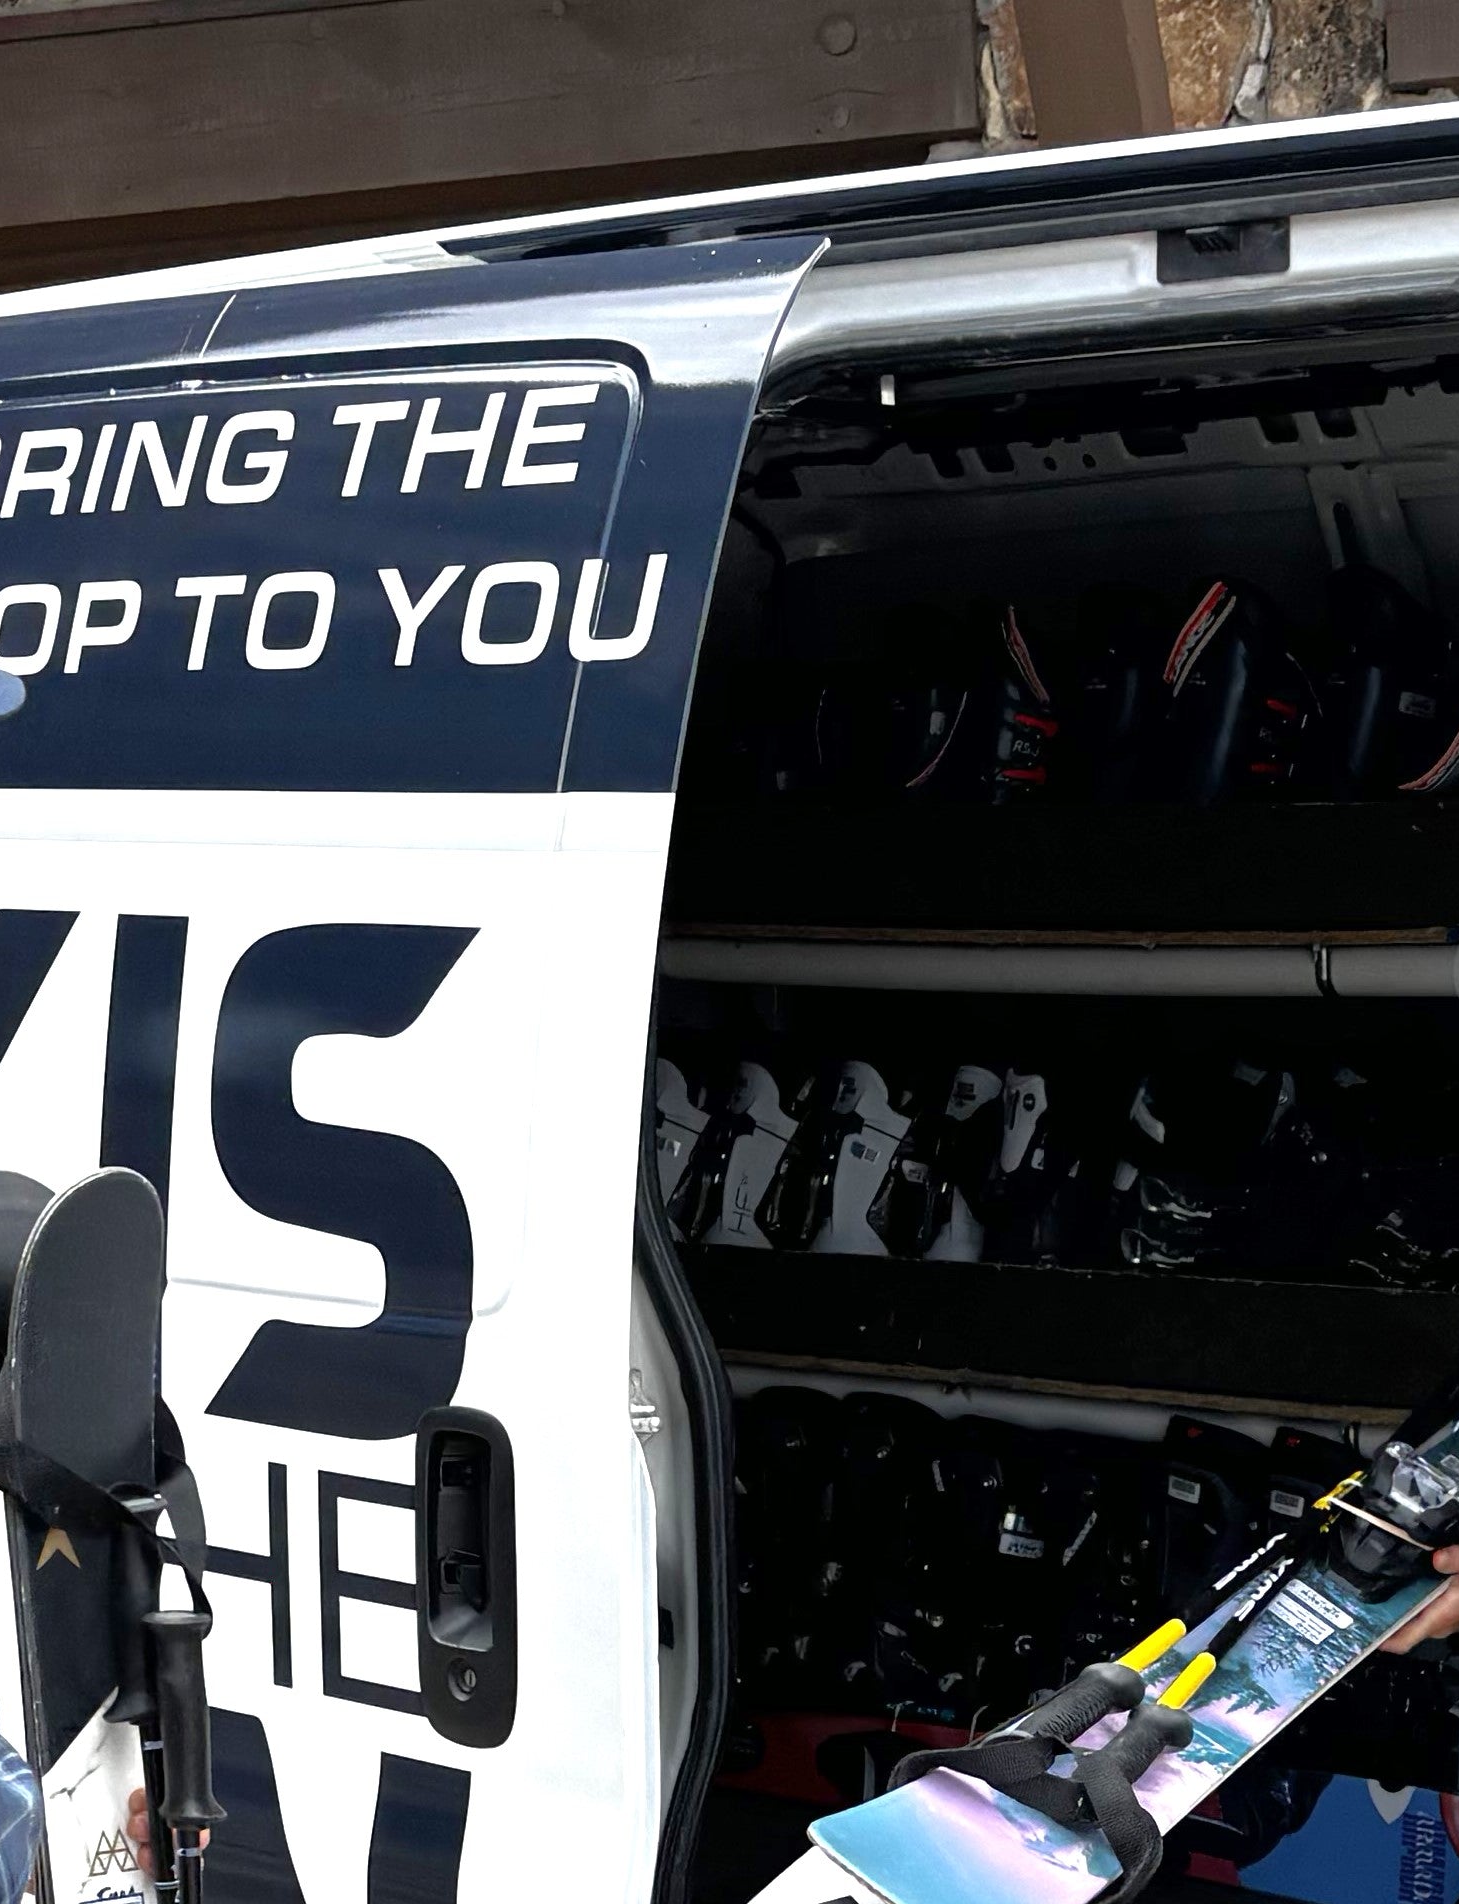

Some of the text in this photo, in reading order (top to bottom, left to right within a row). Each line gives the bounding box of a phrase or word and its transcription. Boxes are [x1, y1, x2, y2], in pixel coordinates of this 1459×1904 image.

[333, 384, 600, 498] THE
[174, 569, 337, 673] TO
[377, 552, 668, 668] YOU
